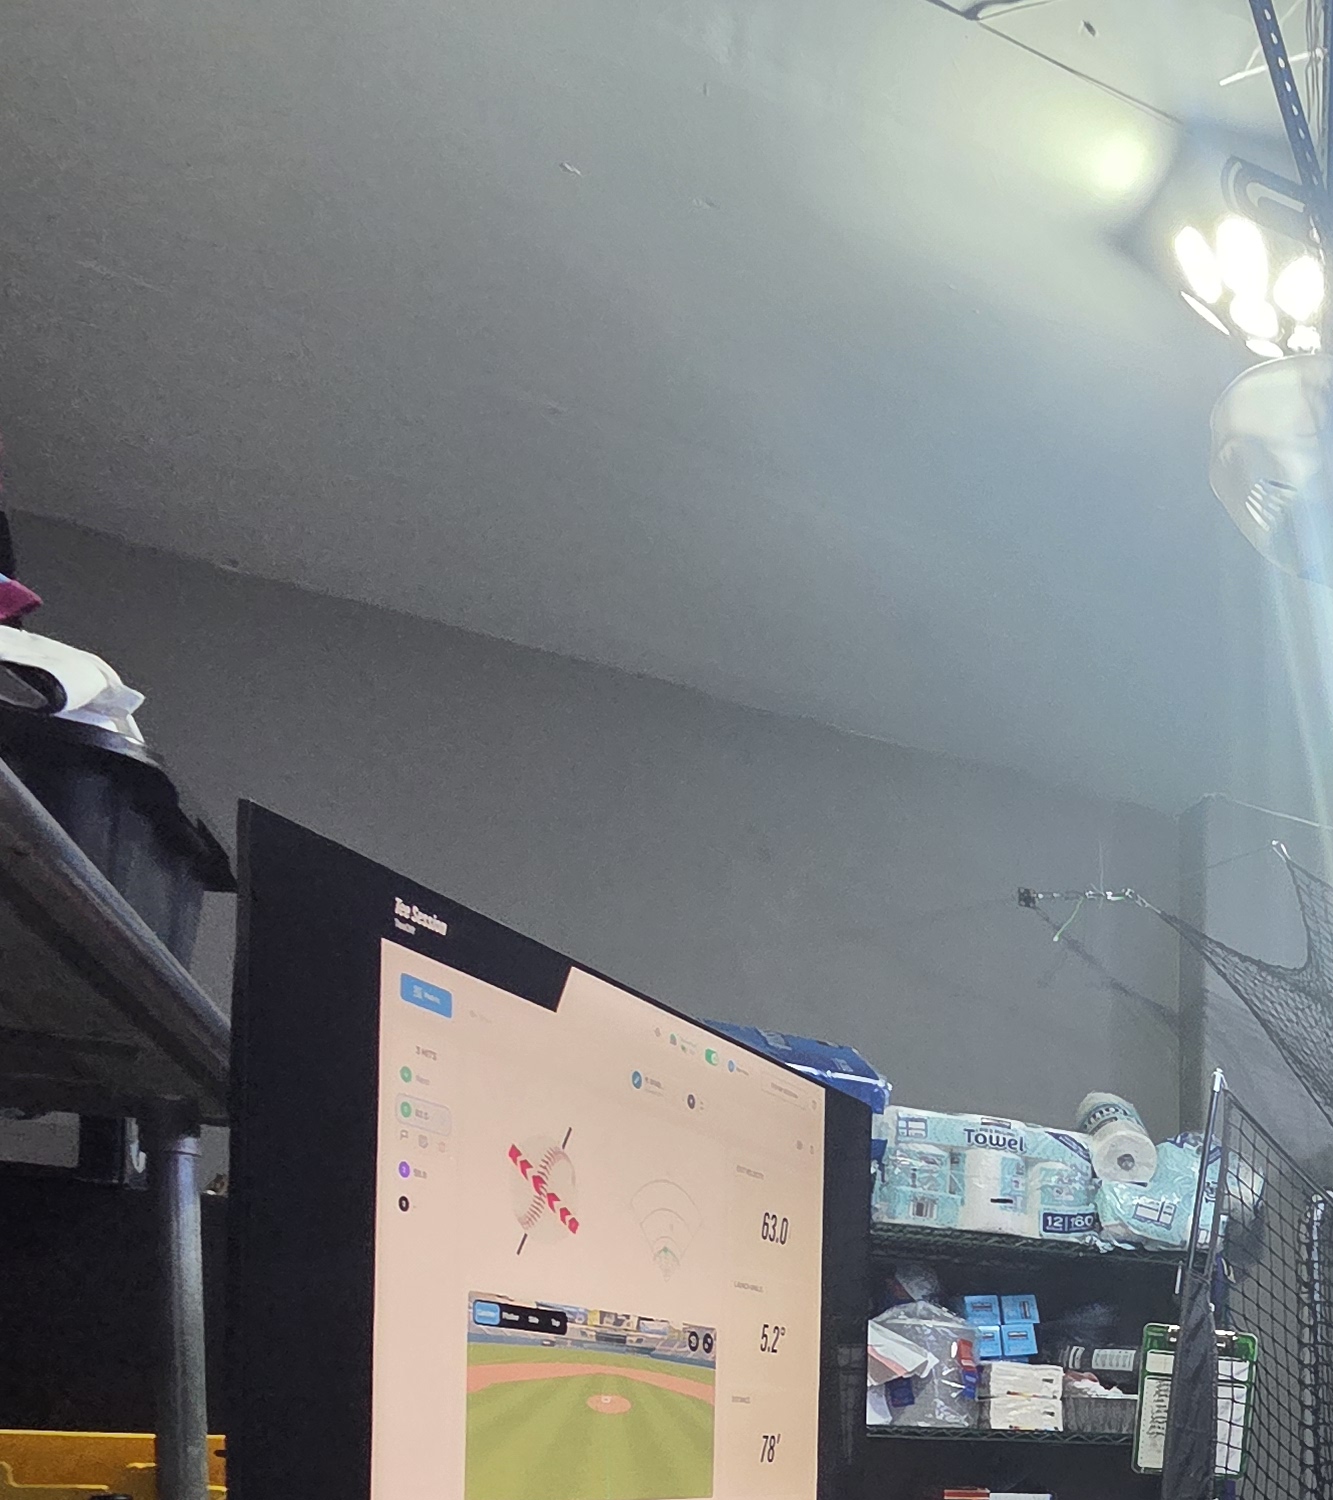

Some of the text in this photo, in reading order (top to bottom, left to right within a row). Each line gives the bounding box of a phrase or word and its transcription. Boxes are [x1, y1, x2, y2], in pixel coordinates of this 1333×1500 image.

[963, 1127, 1025, 1152] Towel
[761, 1212, 789, 1245] 63.0
[1046, 1215, 1064, 1227] 12
